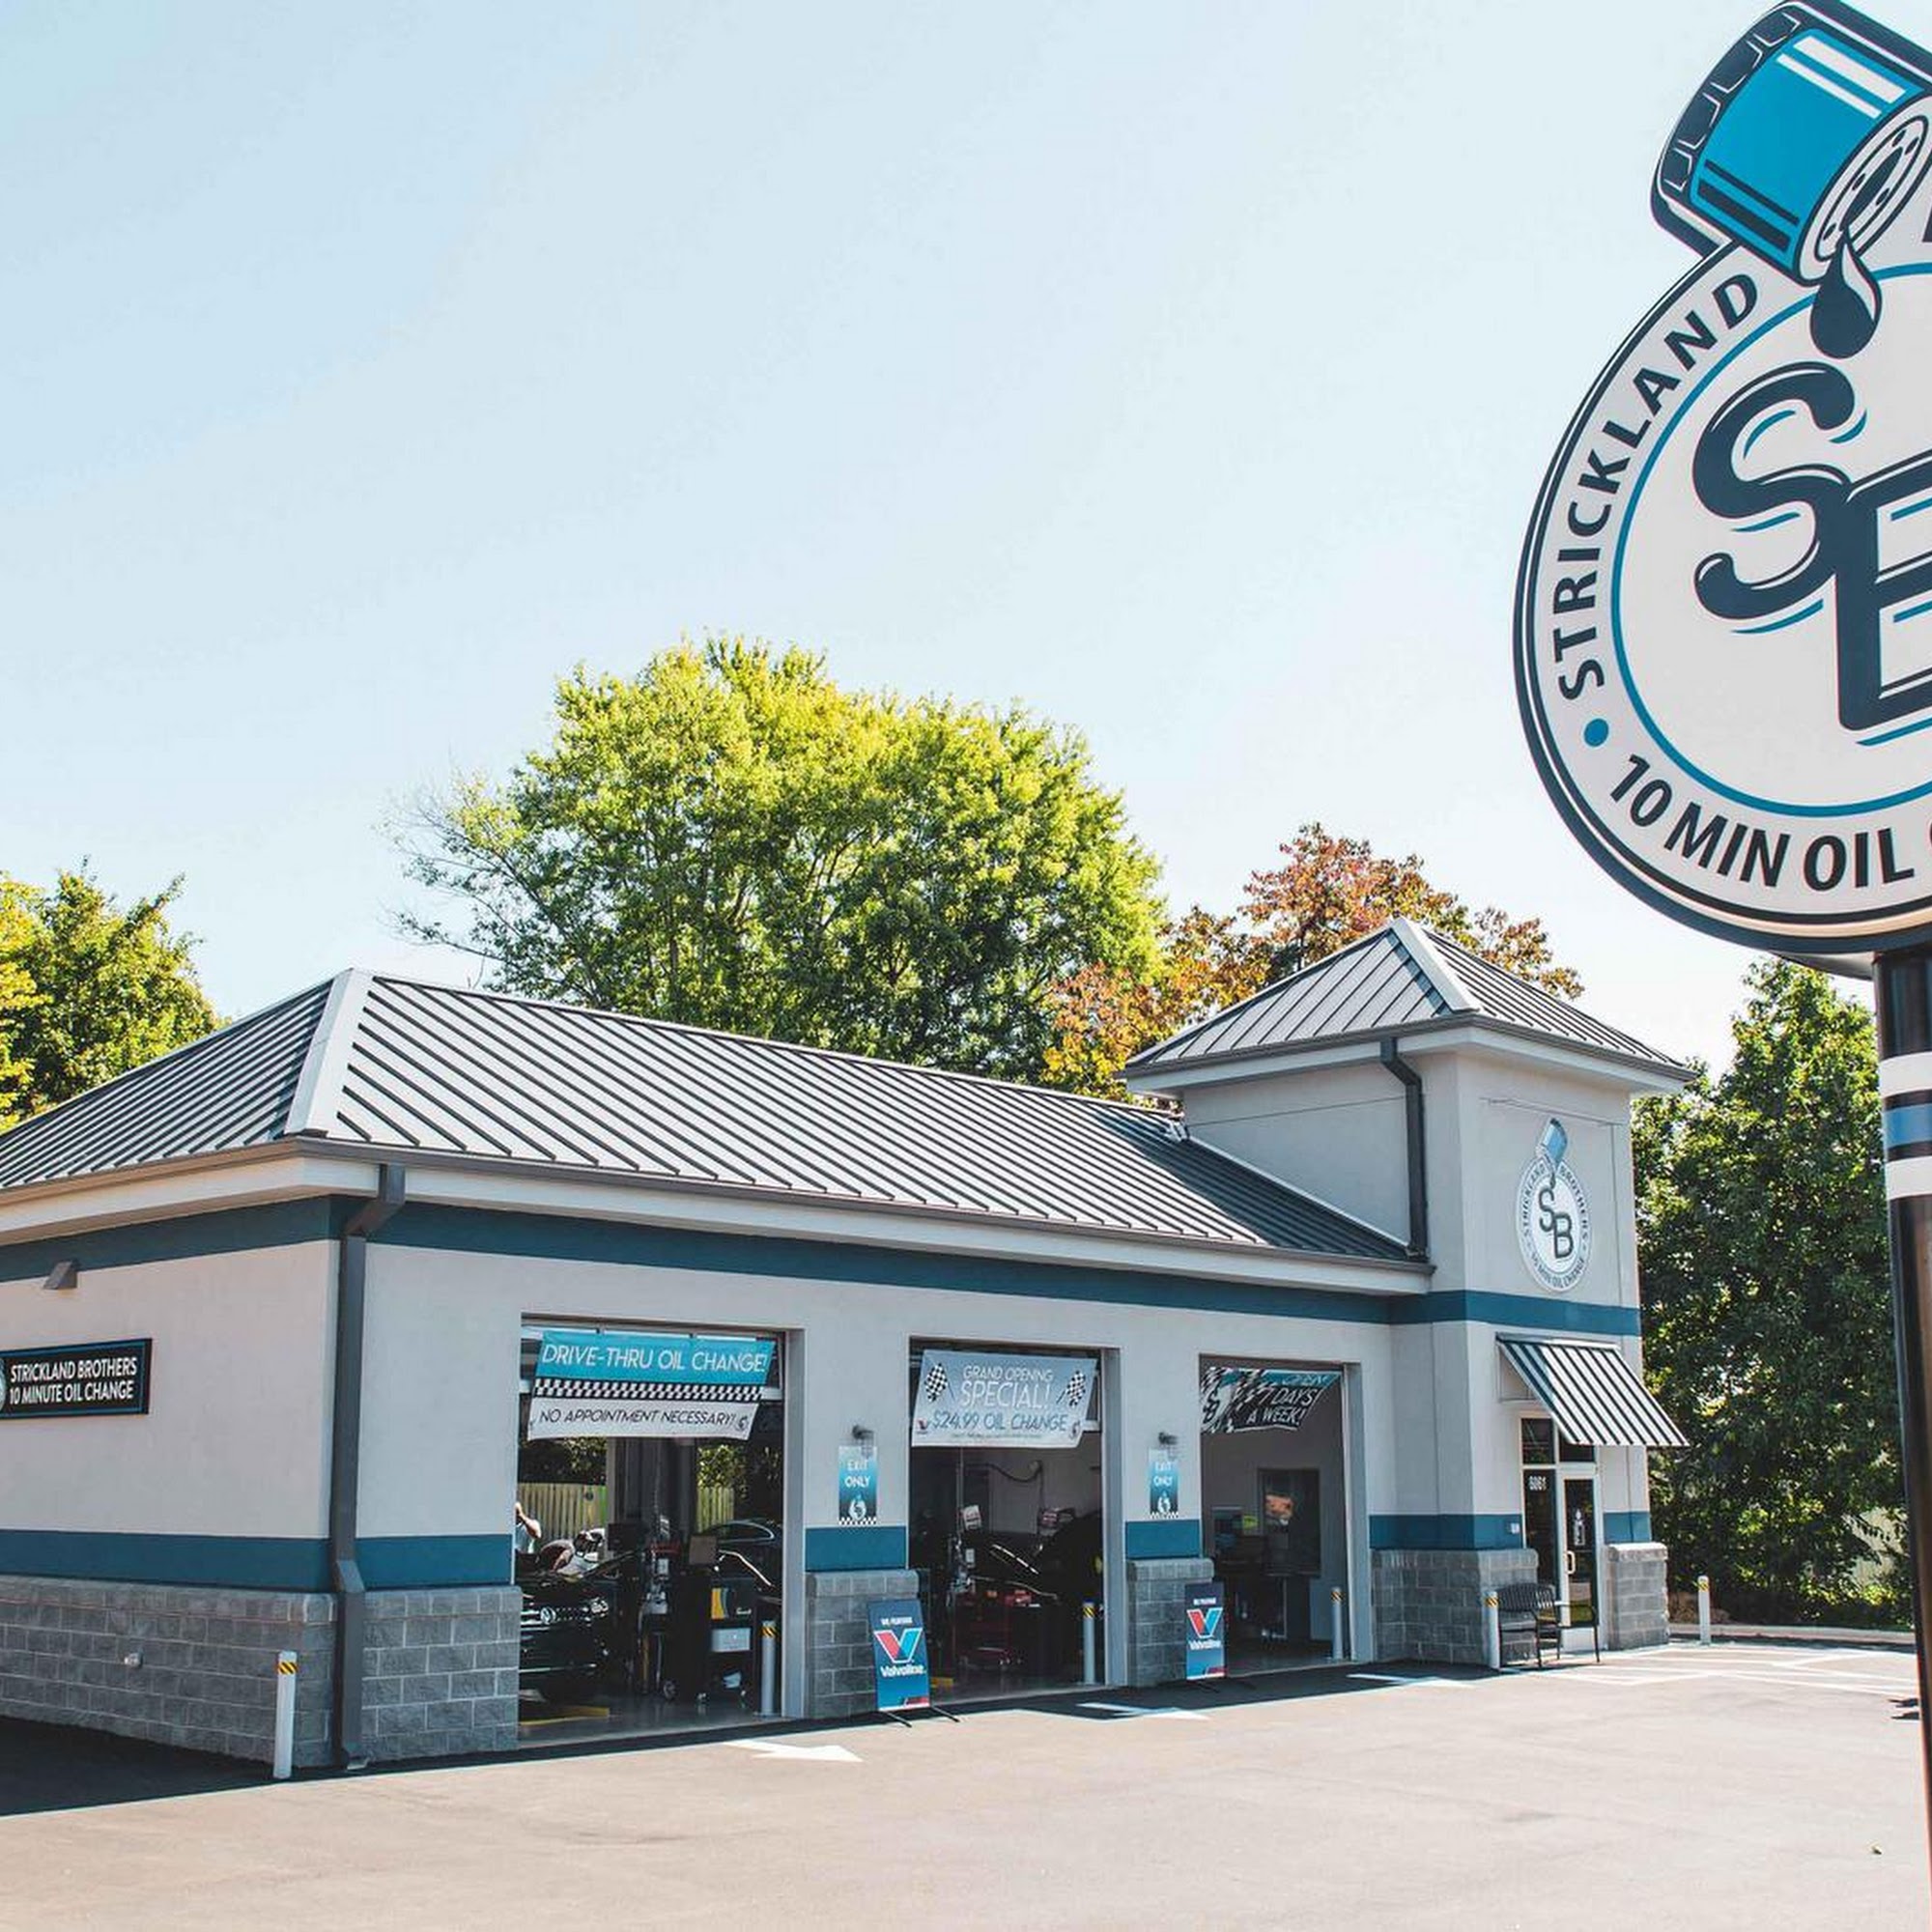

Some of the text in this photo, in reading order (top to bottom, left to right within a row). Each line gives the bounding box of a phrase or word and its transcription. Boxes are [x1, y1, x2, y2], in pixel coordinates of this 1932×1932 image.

[1552, 274, 1758, 700] STRICKLAND
[1610, 753, 1915, 892] 10 MIN OIL
[11, 1356, 137, 1383] STRICKLAND BROTHERS
[542, 1344, 654, 1369] DRIVE-THRU
[658, 1350, 685, 1370] OIL
[962, 1365, 1053, 1382] GRAND OPENING
[10, 1380, 134, 1405] 10 MINUTE OIL CHANGE
[960, 1380, 1050, 1408] SPECIAL!
[540, 1409, 561, 1423] NO
[564, 1409, 659, 1423] APPOINTMENT
[932, 1409, 1070, 1432] $24.99 OIL CHANGE
[844, 1475, 871, 1488] ONLY
